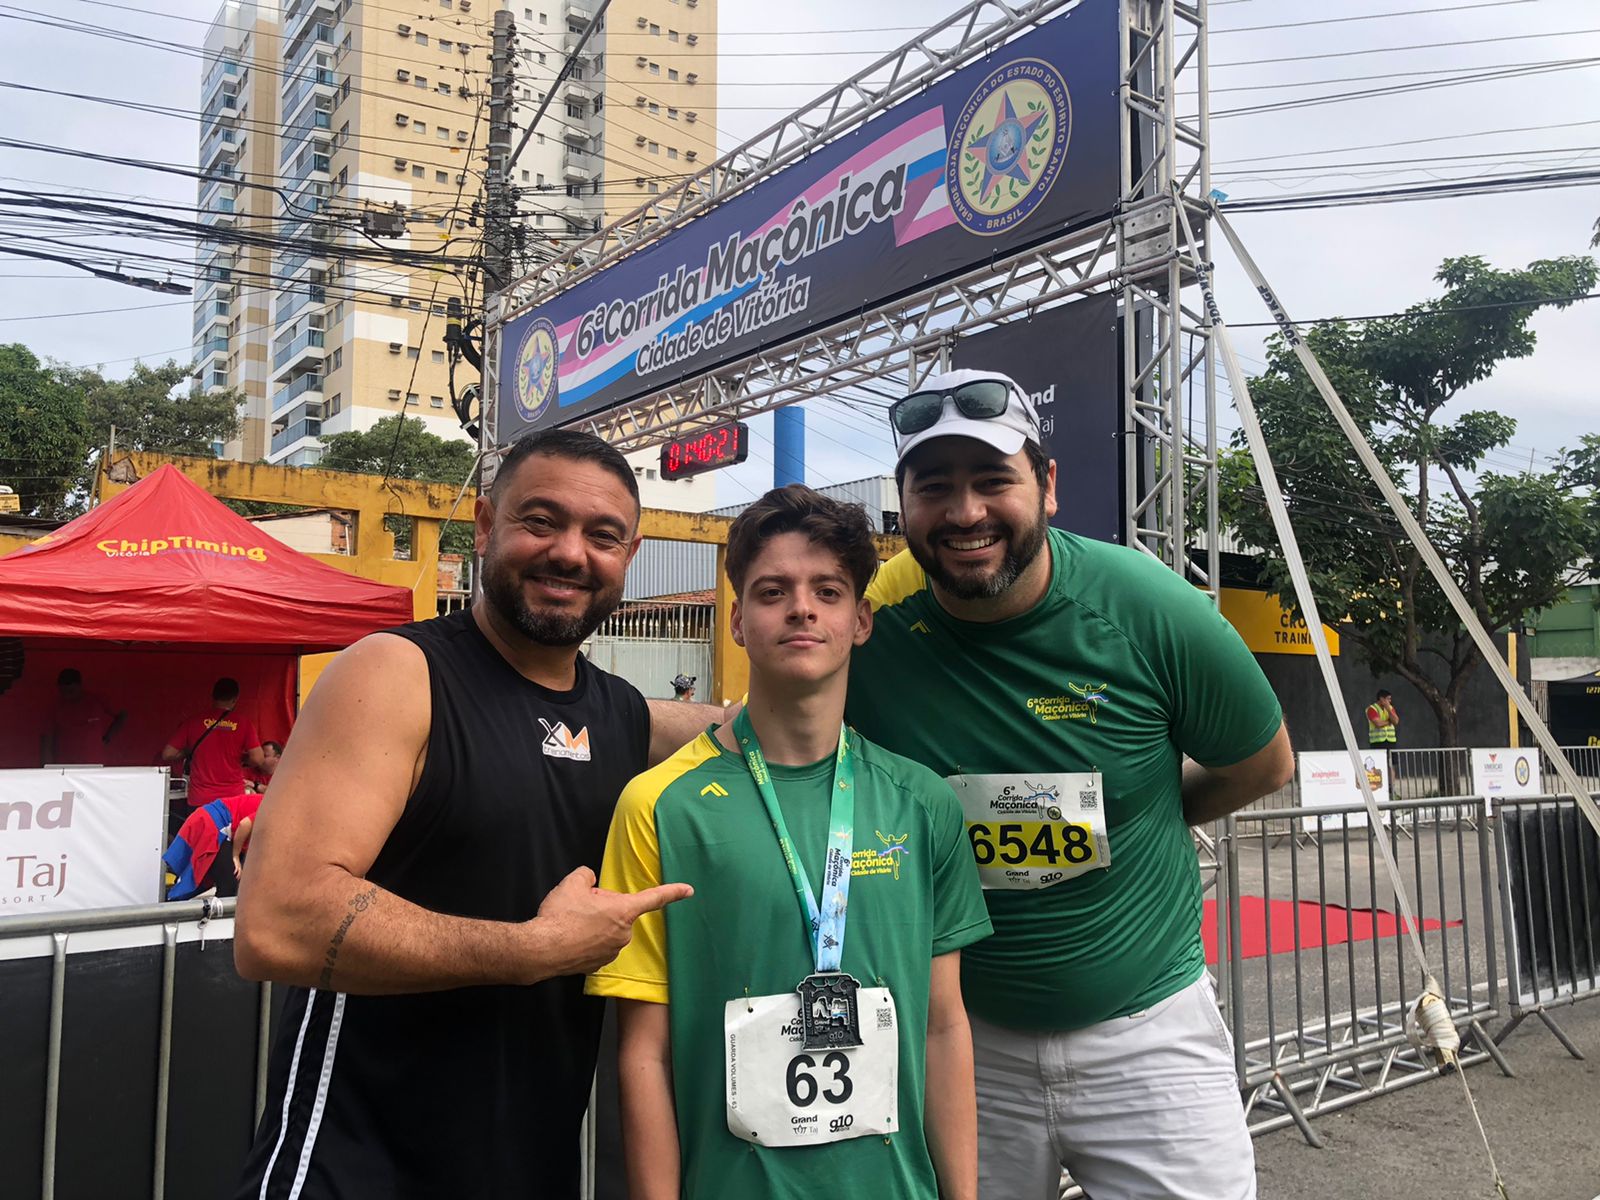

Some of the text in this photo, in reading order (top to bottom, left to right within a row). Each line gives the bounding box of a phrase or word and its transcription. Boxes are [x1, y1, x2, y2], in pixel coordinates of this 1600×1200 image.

[990, 74, 1005, 88] DO
[1006, 65, 1045, 79] ESTADO
[1043, 73, 1056, 88] DO
[949, 152, 958, 184] LOJA
[1038, 147, 1062, 192] SANTO
[950, 185, 974, 222] GRANDE
[986, 208, 1024, 229] BRASIL
[604, 265, 703, 345] Corrida
[702, 161, 907, 302] Maçônica
[635, 275, 811, 376] Cidade de Vitória
[1040, 415, 1055, 436] aj
[97, 536, 268, 562] ChipTiming
[1274, 631, 1312, 645] TRAINI
[1035, 701, 1089, 716] Maçônica
[1038, 696, 1071, 705] Corrida
[990, 800, 1038, 810] Maçônica
[852, 849, 877, 859] orrida
[967, 823, 1093, 865] 6548
[852, 855, 894, 870] açônica
[6, 854, 67, 898] Taj
[1040, 871, 1063, 884] g10
[785, 1051, 854, 1108] 63
[791, 1114, 854, 1133] Grand g10
